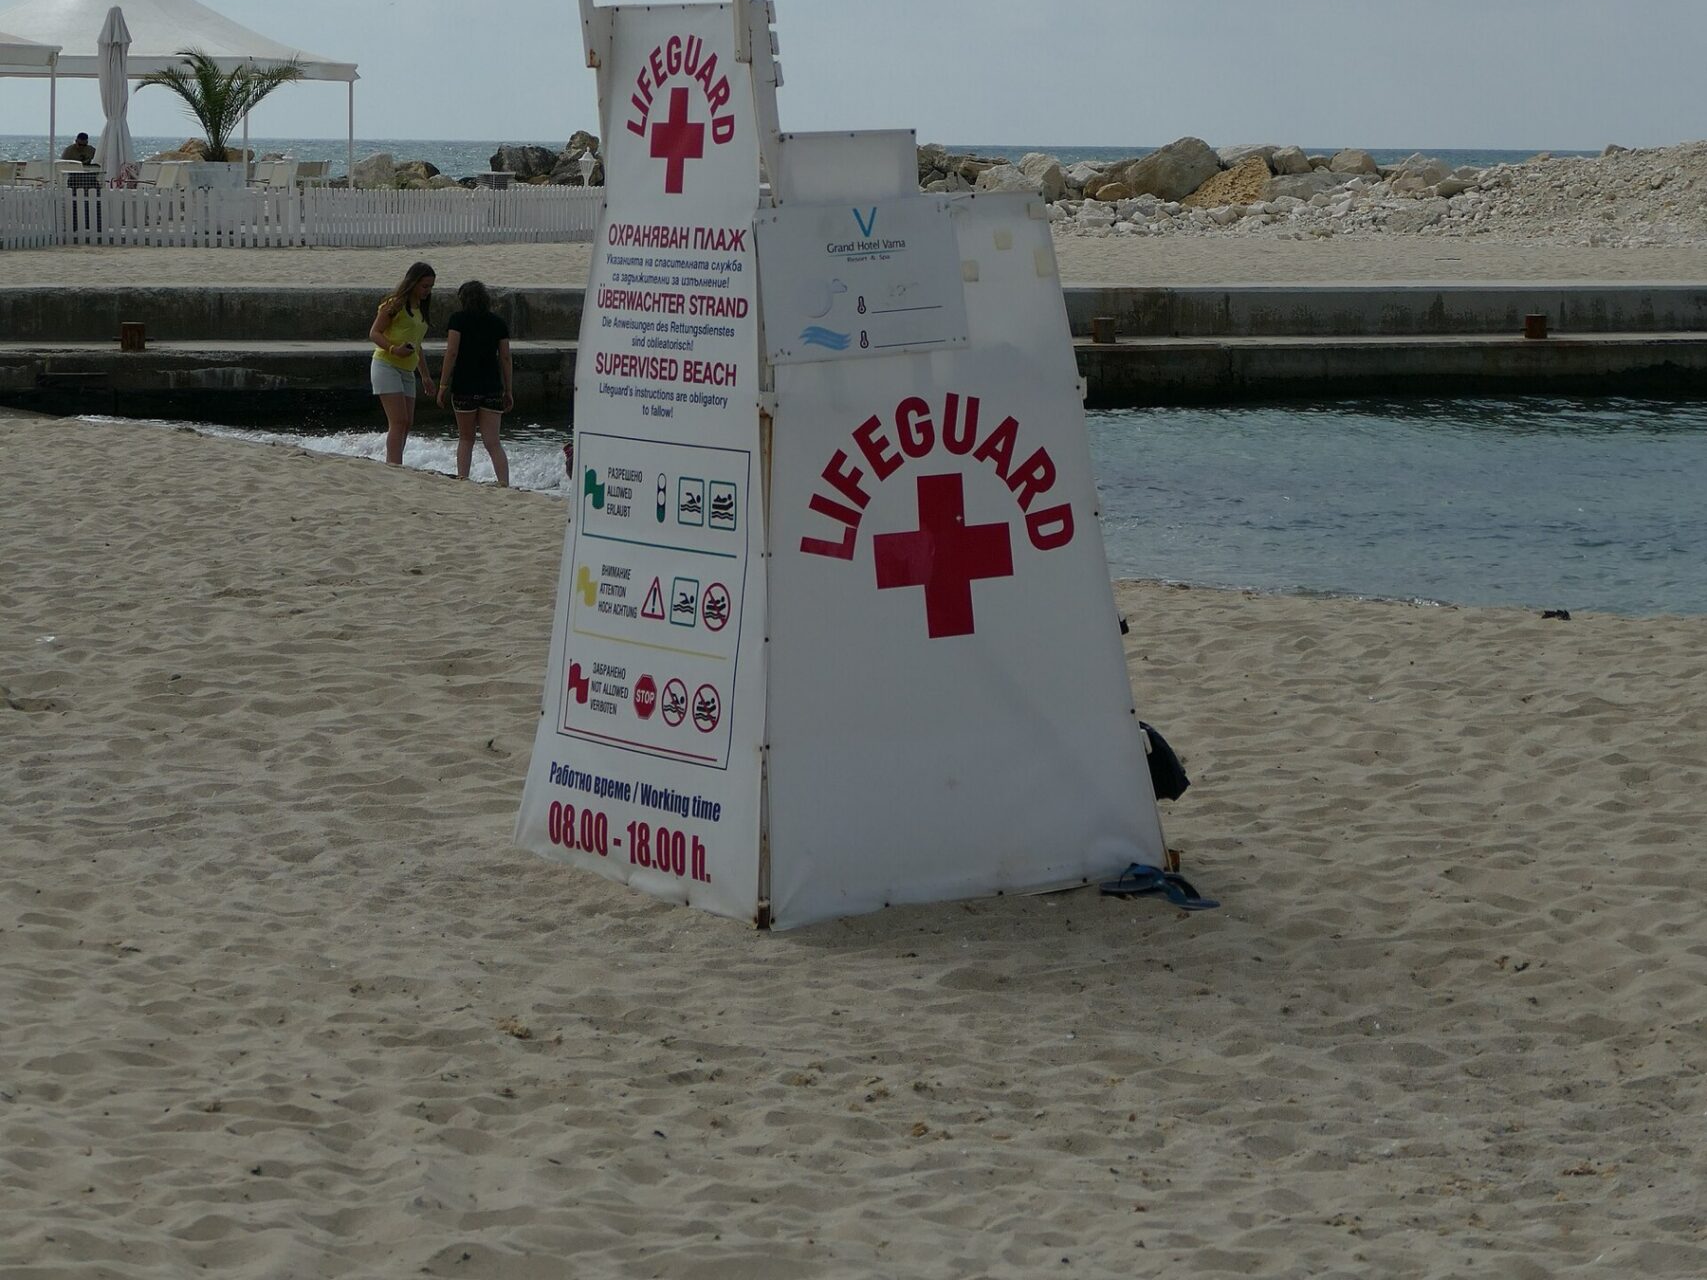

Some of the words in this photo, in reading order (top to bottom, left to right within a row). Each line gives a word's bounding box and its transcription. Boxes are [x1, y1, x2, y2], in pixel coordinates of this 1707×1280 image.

[627, 35, 735, 145] LIFEGUARD
[608, 223, 690, 250] ОХРАНЯВАН
[693, 227, 747, 252] ПЛАЖ
[826, 242, 855, 253] Grand
[857, 240, 880, 251] Hotel
[882, 239, 906, 250] Varna
[606, 253, 643, 267] Указанията
[645, 258, 653, 267] на
[654, 258, 709, 271] спасителната
[711, 259, 743, 274] служба
[612, 273, 619, 282] са
[620, 272, 670, 286] задължителни
[671, 276, 679, 285] за
[681, 276, 730, 289] изпълнение!
[597, 283, 685, 315] ÜBERWACHTER
[689, 294, 748, 319] STRAND
[602, 316, 612, 328] Die
[613, 317, 654, 333] Anweisungen
[656, 320, 669, 333] des
[670, 321, 735, 338] Rettungsdienstes
[632, 336, 645, 348] sind
[595, 352, 679, 381] SUPERVISED
[683, 360, 737, 387] BEACH
[599, 383, 633, 398] Lifeguard's
[635, 388, 674, 401] instructions
[675, 392, 687, 402] are
[689, 392, 728, 409] obligatory
[642, 404, 650, 416] to
[607, 467, 643, 483] РАЗРЕШЕНО
[800, 392, 1075, 561] LIFEGUARD
[607, 485, 633, 500] ALLOWED
[606, 503, 631, 518] ERLAUBT
[601, 564, 632, 581] ВНИМАНИЕ
[599, 583, 627, 598] ATTENTION
[598, 601, 613, 615] HOCH
[612, 603, 638, 619] ACHTUNG
[592, 662, 626, 680] ЗАБРАНЕНО
[591, 680, 602, 693] NOT
[603, 683, 629, 699] ALLOWED
[635, 689, 655, 705] STOP
[590, 699, 617, 716] VERBOTEN
[549, 761, 592, 793] Работно
[594, 775, 631, 803] време
[632, 781, 639, 805] /
[641, 782, 690, 818] Working
[692, 795, 721, 822] time
[548, 800, 609, 857] 08.00
[613, 837, 622, 847] -
[626, 821, 687, 877] 18.00
[691, 834, 712, 884] h.
